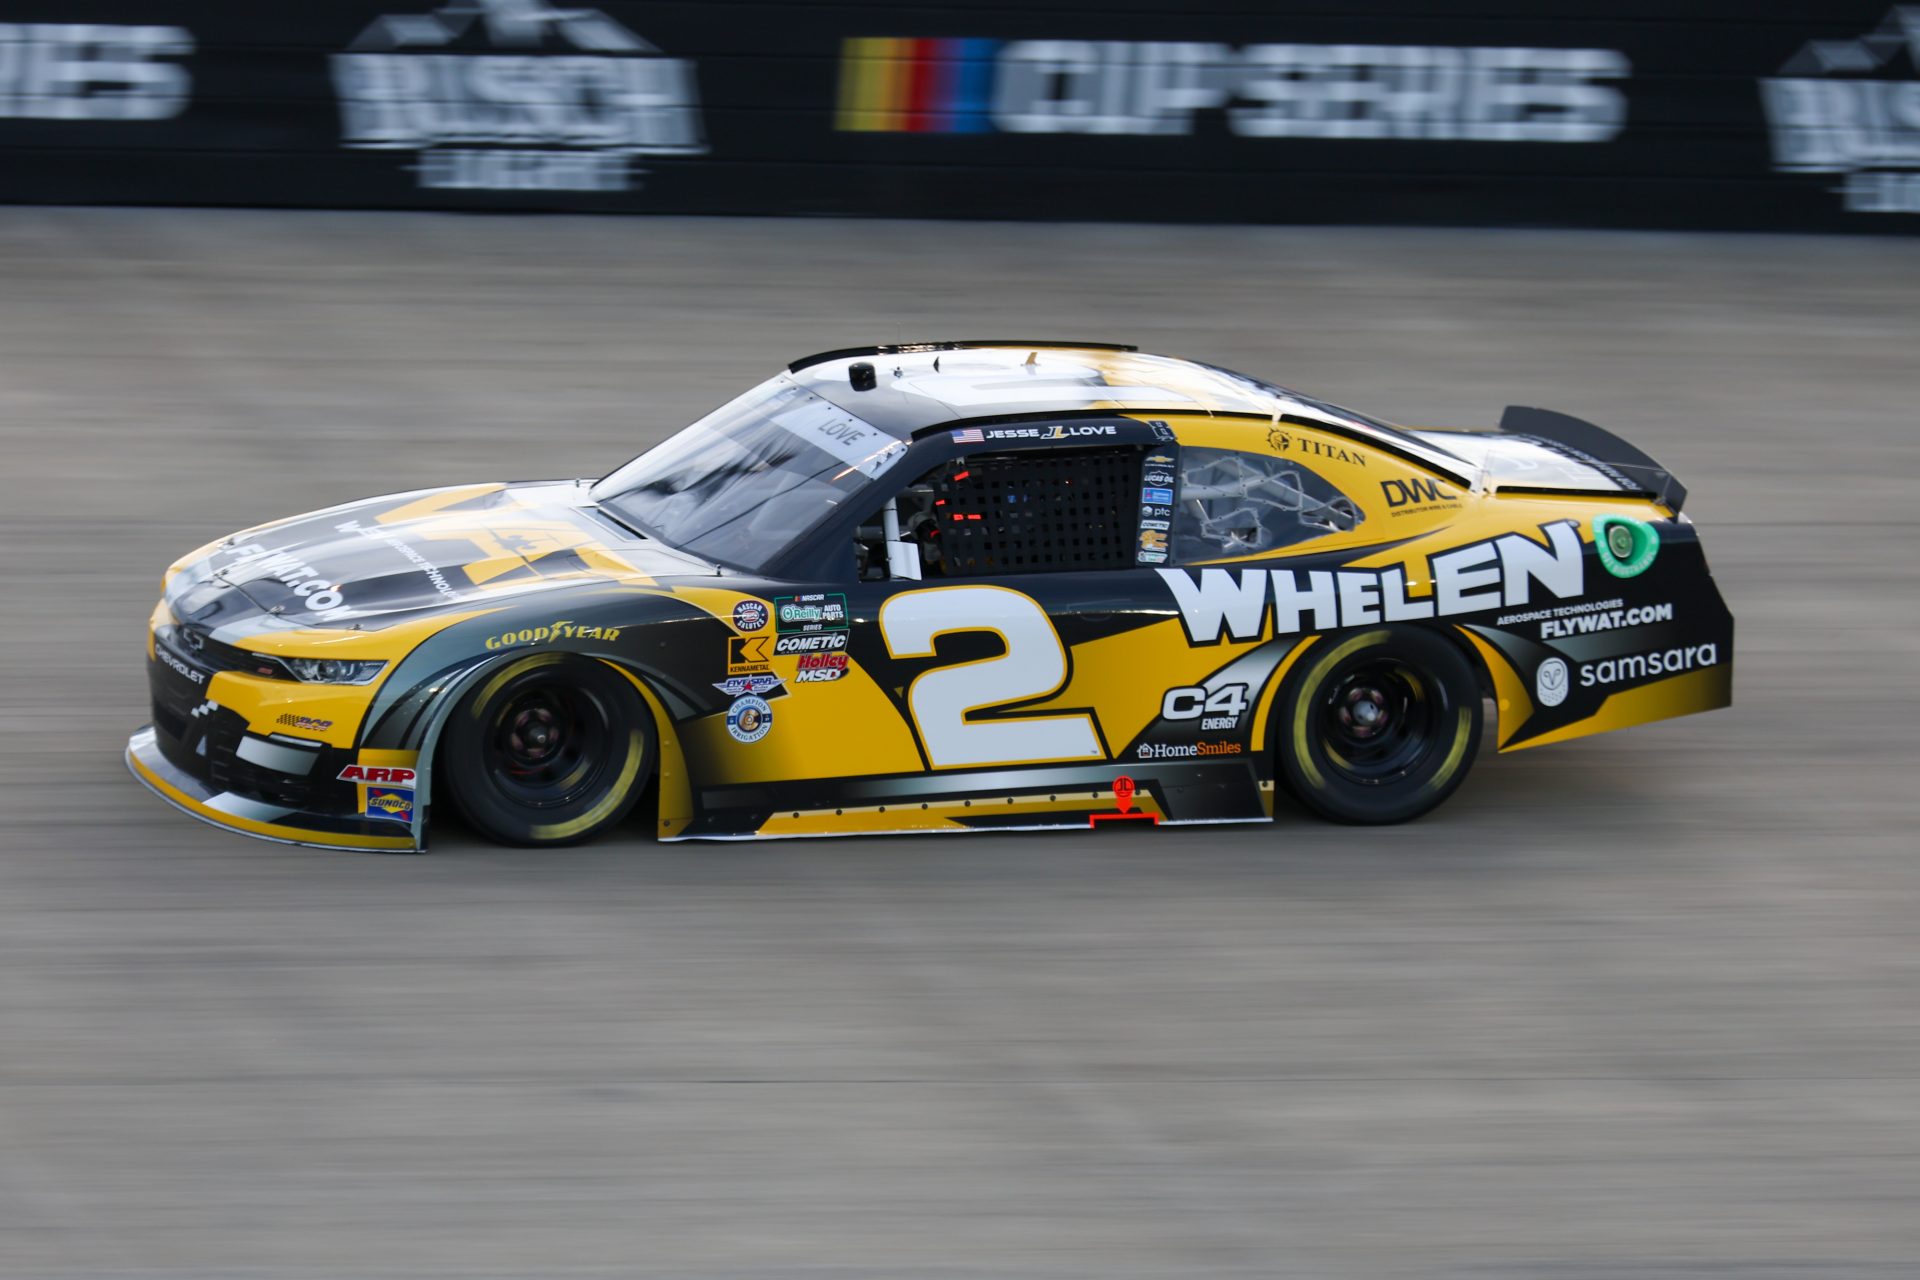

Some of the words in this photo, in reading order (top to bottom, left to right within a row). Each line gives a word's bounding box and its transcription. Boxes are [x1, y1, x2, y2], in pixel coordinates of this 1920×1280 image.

[818, 418, 865, 446] LOVE
[986, 428, 1040, 439] JESSE
[1069, 425, 1117, 436] LOVE
[1297, 437, 1367, 467] TITAN
[1144, 474, 1164, 482] LUCAS
[1154, 507, 1171, 517] ptc
[1154, 521, 1584, 643] WHELEN
[801, 593, 825, 602] NASCAR
[736, 602, 763, 613] NASCAR
[782, 605, 821, 621] O'Reilly
[822, 611, 844, 620] PARTS
[824, 604, 842, 612] AUTO
[1497, 610, 1552, 626] AEROSPACE
[1553, 598, 1624, 618] TECHNOLOGIES
[737, 618, 765, 630] SALUTES
[803, 624, 823, 632] SERIES
[1541, 603, 1673, 639] FLYWAT.COM
[777, 633, 847, 652] COMETIC
[155, 644, 205, 685] CHEVROLET
[730, 664, 769, 673] KENNAMETAL
[798, 653, 850, 671] Holley
[1580, 643, 1717, 687] samsara
[751, 677, 773, 685] STAR
[796, 668, 841, 683] MSD
[880, 585, 1107, 770] 2
[732, 698, 767, 714] CHAMPION
[1162, 684, 1248, 721] C4
[1201, 716, 1239, 731] ENERGY
[731, 725, 768, 741] IRRIGATION
[1154, 741, 1242, 758] HomeSmiles
[341, 766, 416, 783] ARP
[371, 798, 412, 811] SUNOCO
